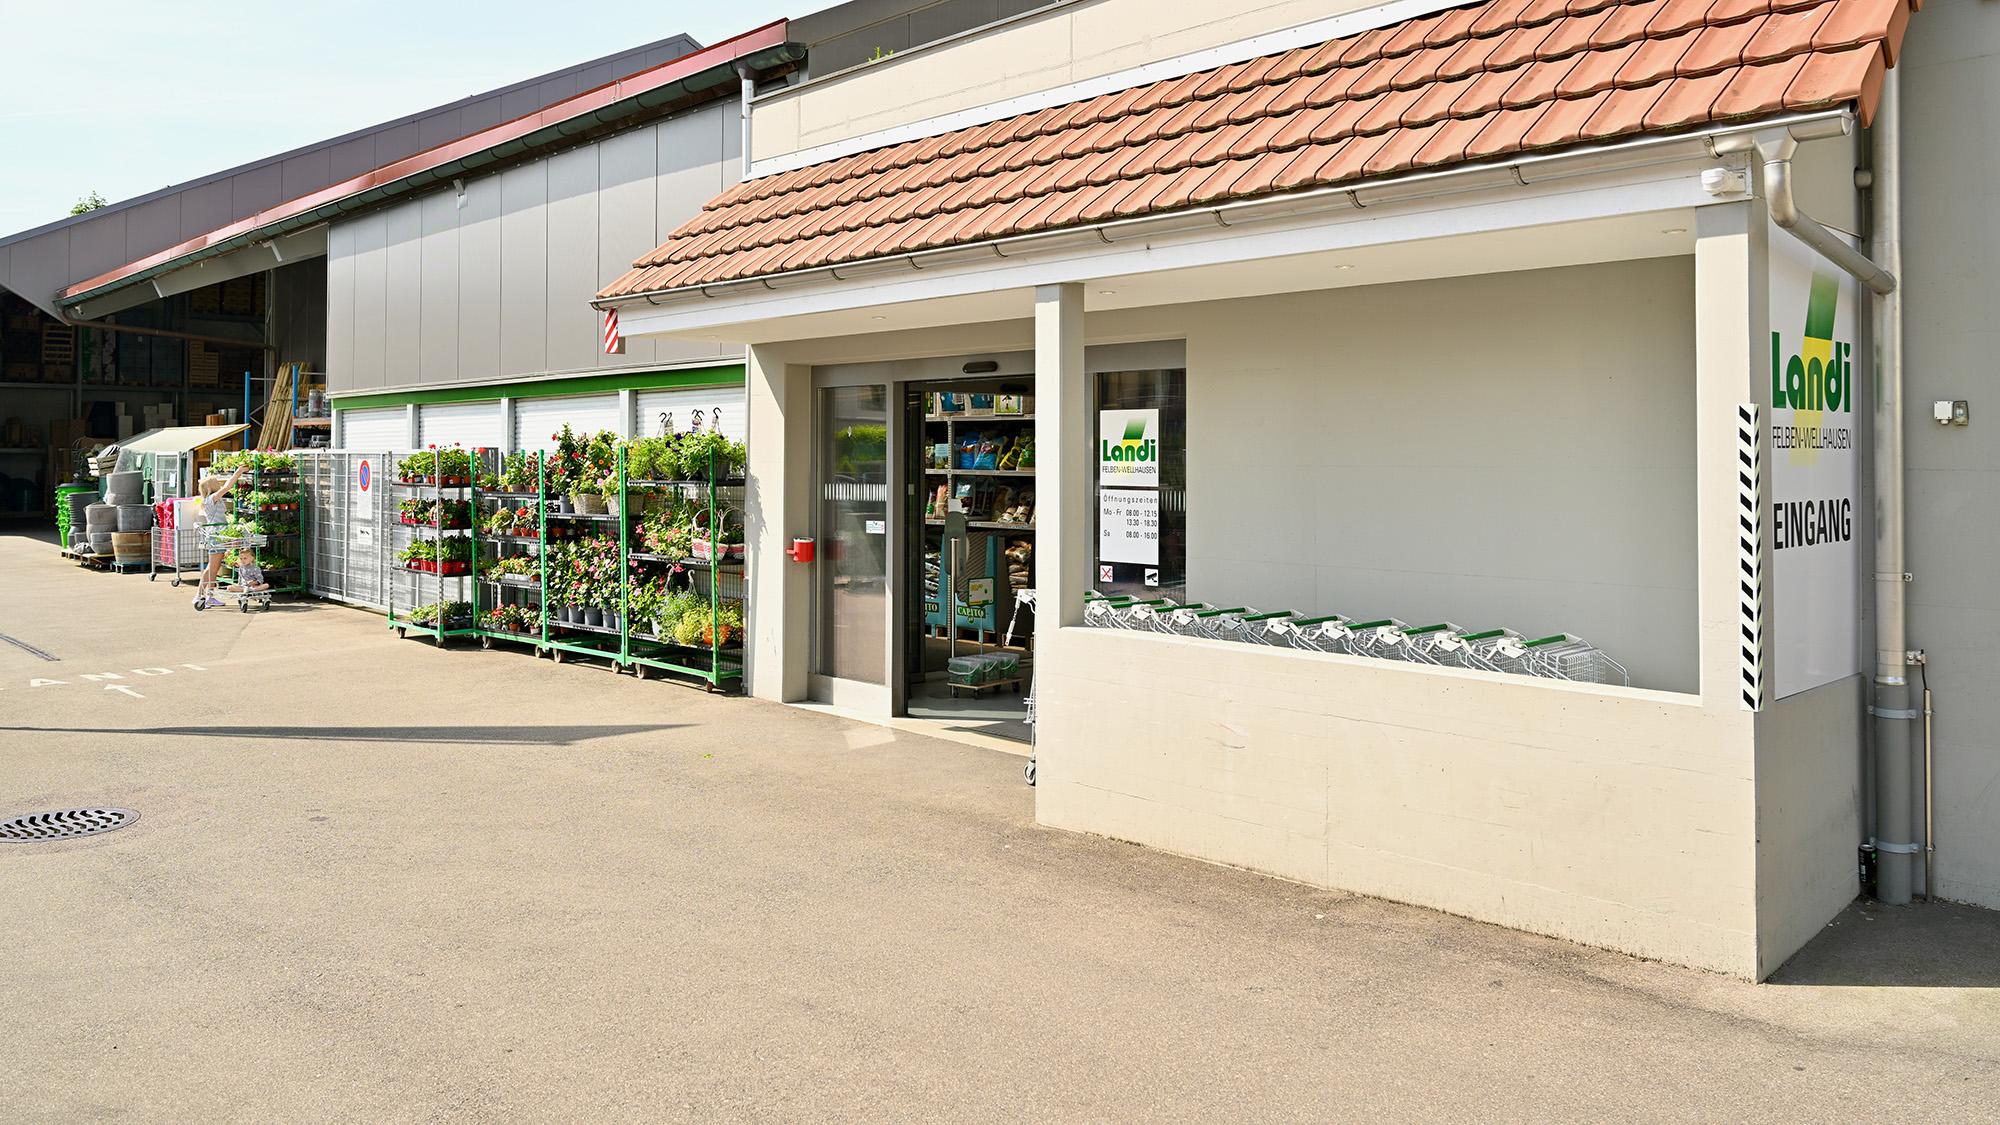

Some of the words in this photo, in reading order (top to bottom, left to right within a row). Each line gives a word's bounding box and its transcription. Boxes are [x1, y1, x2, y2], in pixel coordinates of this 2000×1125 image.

[1772, 331, 1850, 413] Landi
[1772, 426, 1851, 449] FELBEN-WELLHAUSEN
[1103, 439, 1156, 462] Landi
[1103, 494, 1157, 504] Öffnungszeiten
[1773, 498, 1851, 550] EINGANG
[957, 606, 984, 617] CAPITO
[0, 663, 209, 690] ANDI
